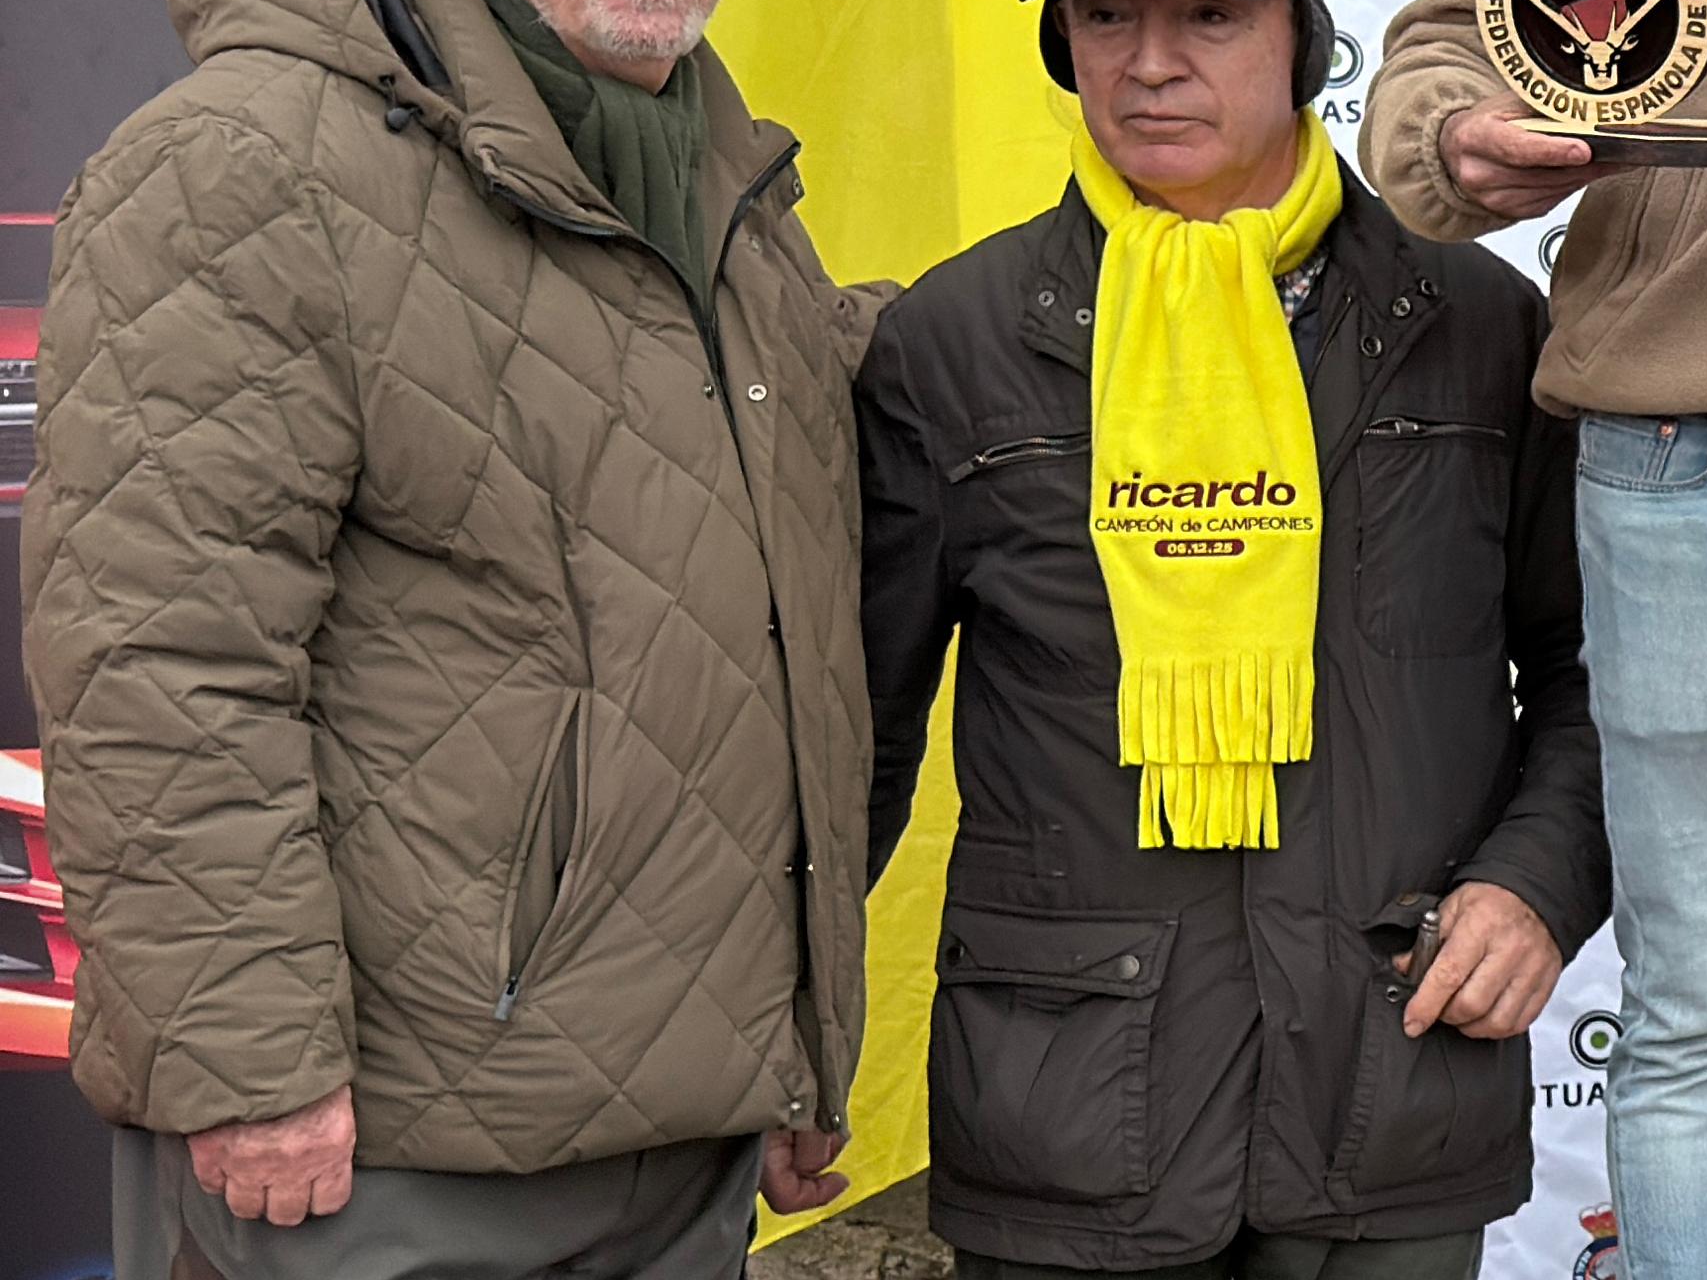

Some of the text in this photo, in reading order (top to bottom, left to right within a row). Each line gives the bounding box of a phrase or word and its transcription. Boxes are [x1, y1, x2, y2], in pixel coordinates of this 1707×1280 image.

[1598, 50, 1702, 122] ESPAÑOLA
[1688, 5, 1707, 39] DE
[1108, 471, 1296, 509] ricardo
[1095, 515, 1314, 533] CAMPEÓN de CAMPEONES
